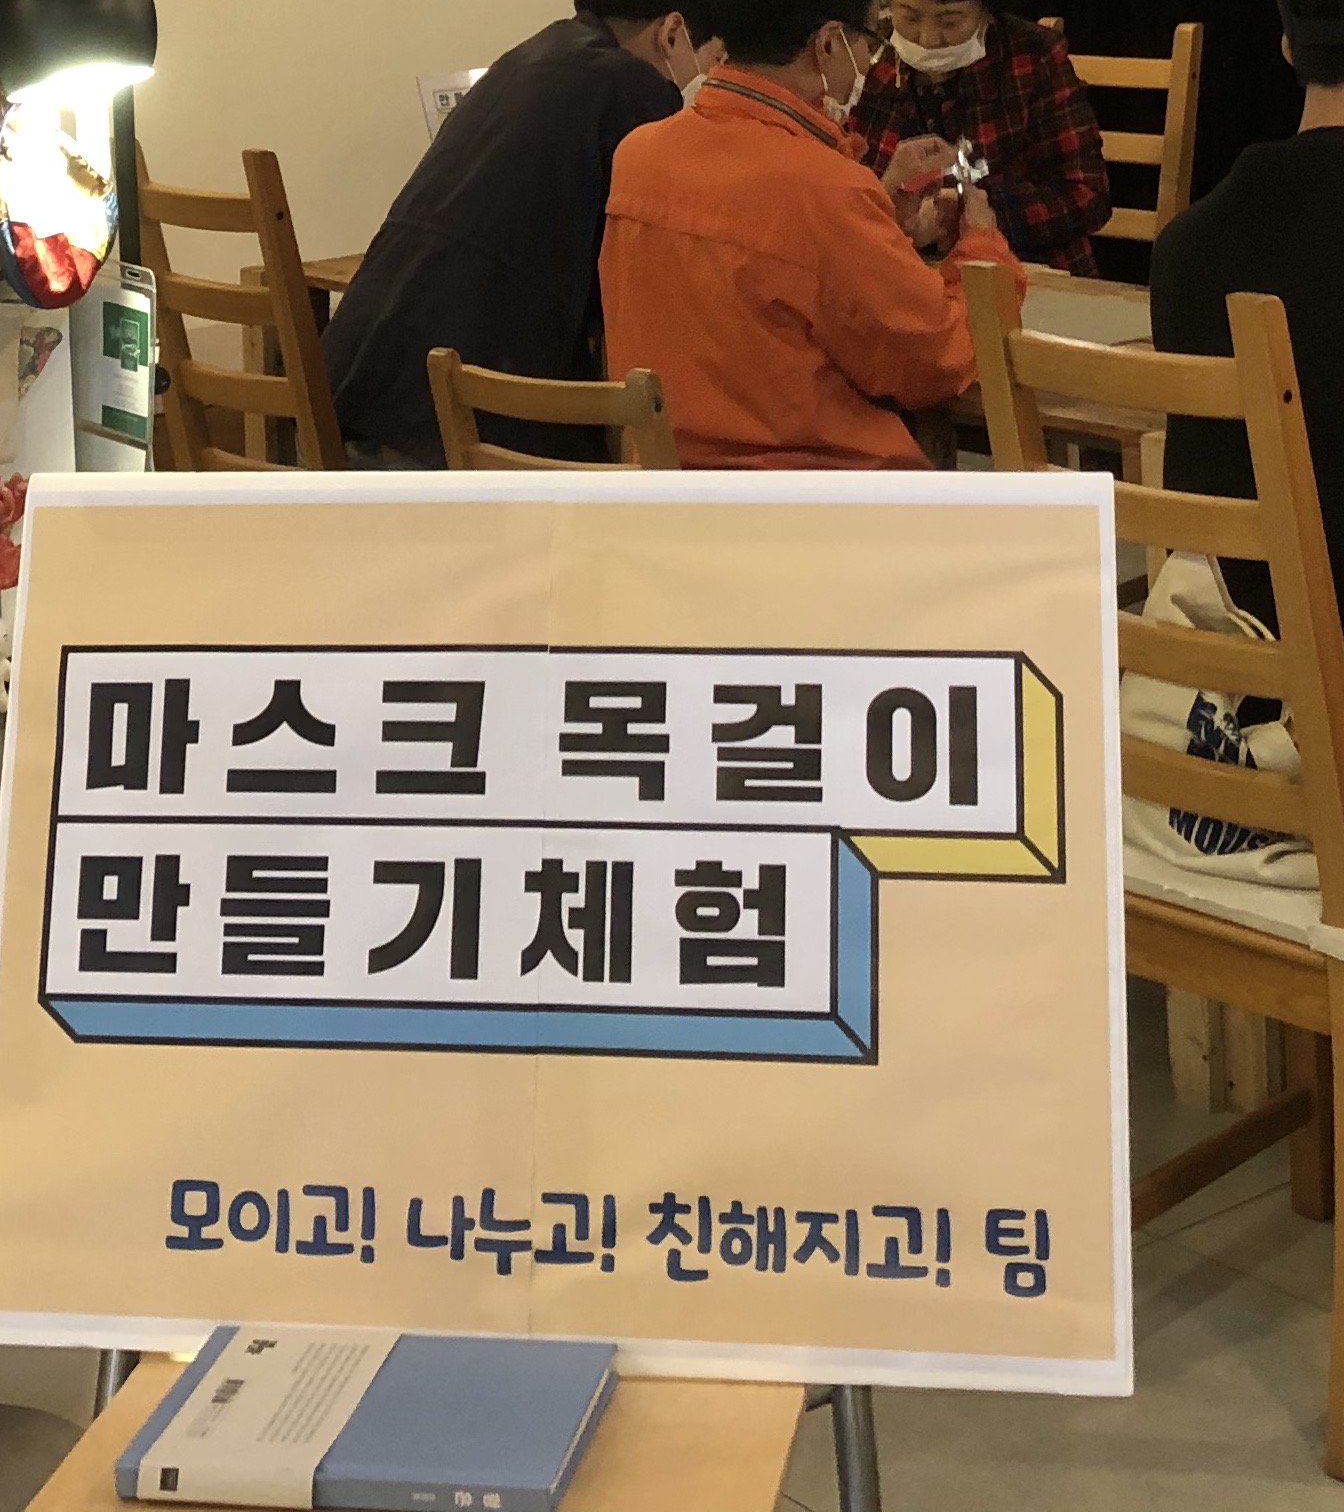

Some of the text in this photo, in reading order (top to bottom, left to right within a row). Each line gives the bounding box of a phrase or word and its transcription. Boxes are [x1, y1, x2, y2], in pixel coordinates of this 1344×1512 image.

[83, 677, 979, 808] 마스크 목걸이
[76, 852, 789, 989] 만들기체험
[164, 1178, 1053, 1299] 모이고! 나누고! 친해지고! 팀
